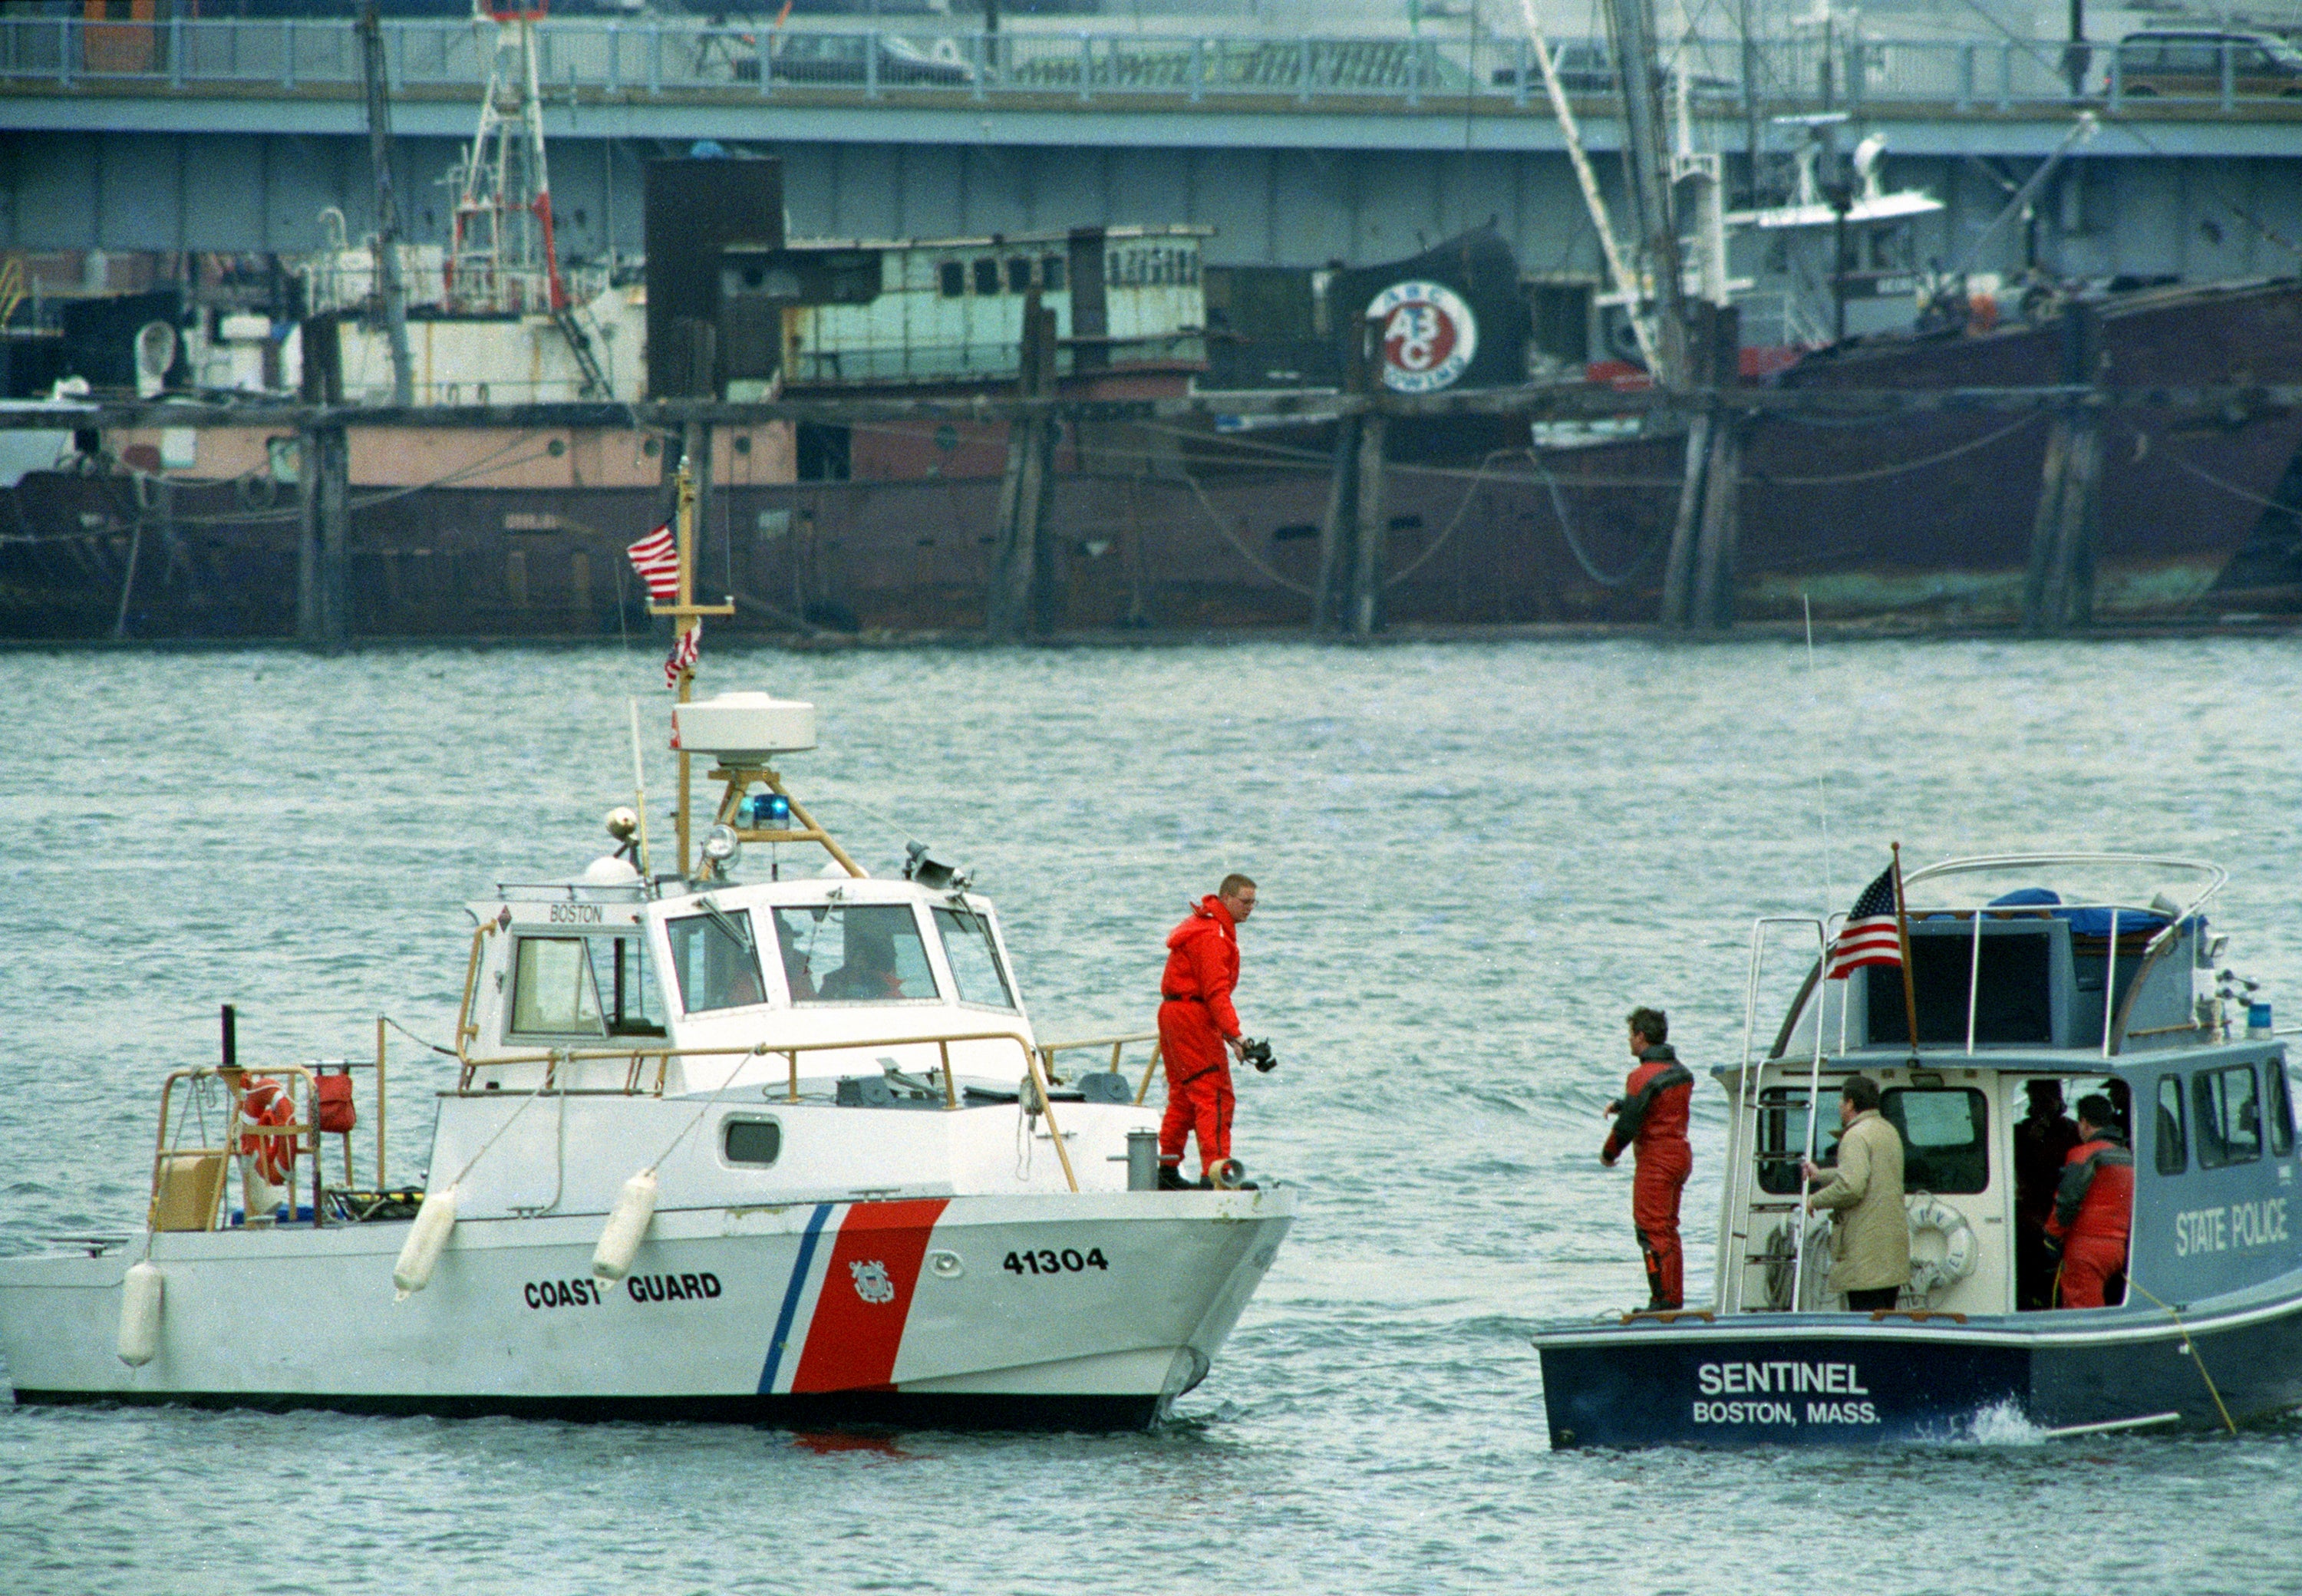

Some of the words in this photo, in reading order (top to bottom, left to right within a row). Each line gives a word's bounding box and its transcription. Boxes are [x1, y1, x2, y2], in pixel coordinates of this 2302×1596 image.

[550, 904, 602, 923] BOSTON
[2176, 1206, 2226, 1257] STATE
[2231, 1197, 2288, 1248] POLICE
[1003, 1247, 1109, 1274] 41304
[524, 1278, 601, 1310] COAST
[627, 1271, 722, 1303] GUARD
[1698, 1362, 1868, 1395] SENTINEL
[1693, 1402, 1797, 1427] BOSTON,
[1806, 1402, 1882, 1425] MASS.
